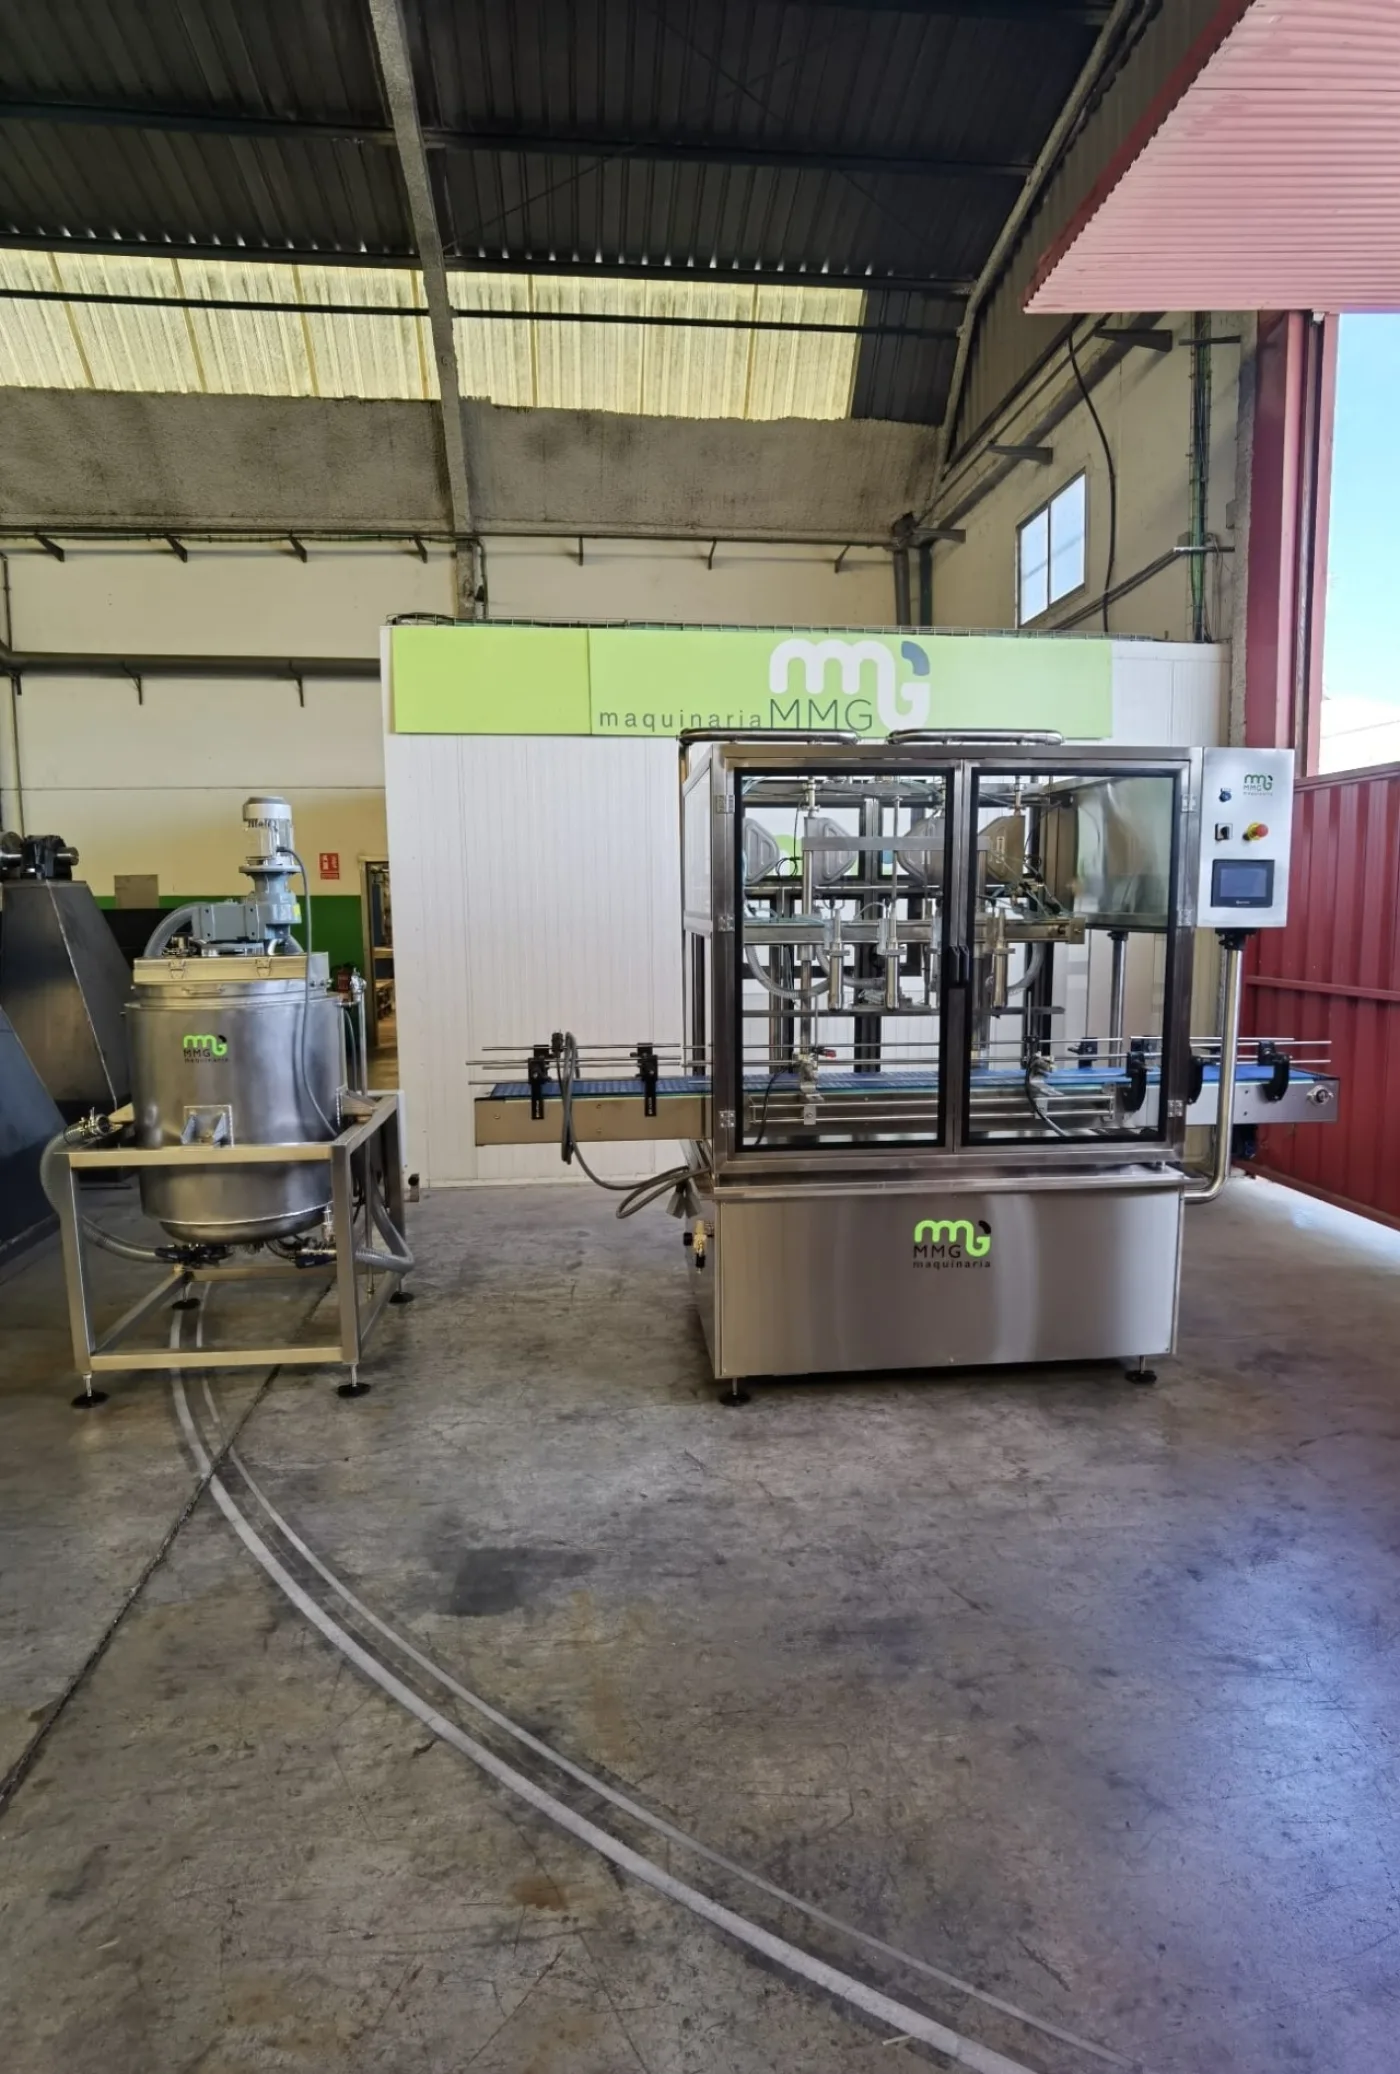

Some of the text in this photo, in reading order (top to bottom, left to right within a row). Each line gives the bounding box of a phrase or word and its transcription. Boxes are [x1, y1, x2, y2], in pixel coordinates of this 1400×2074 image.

[599, 698, 873, 732] maquinaria MMG
[184, 1048, 211, 1057] MMG
[913, 1244, 962, 1259] MMG
[913, 1260, 991, 1270] maquinaria
